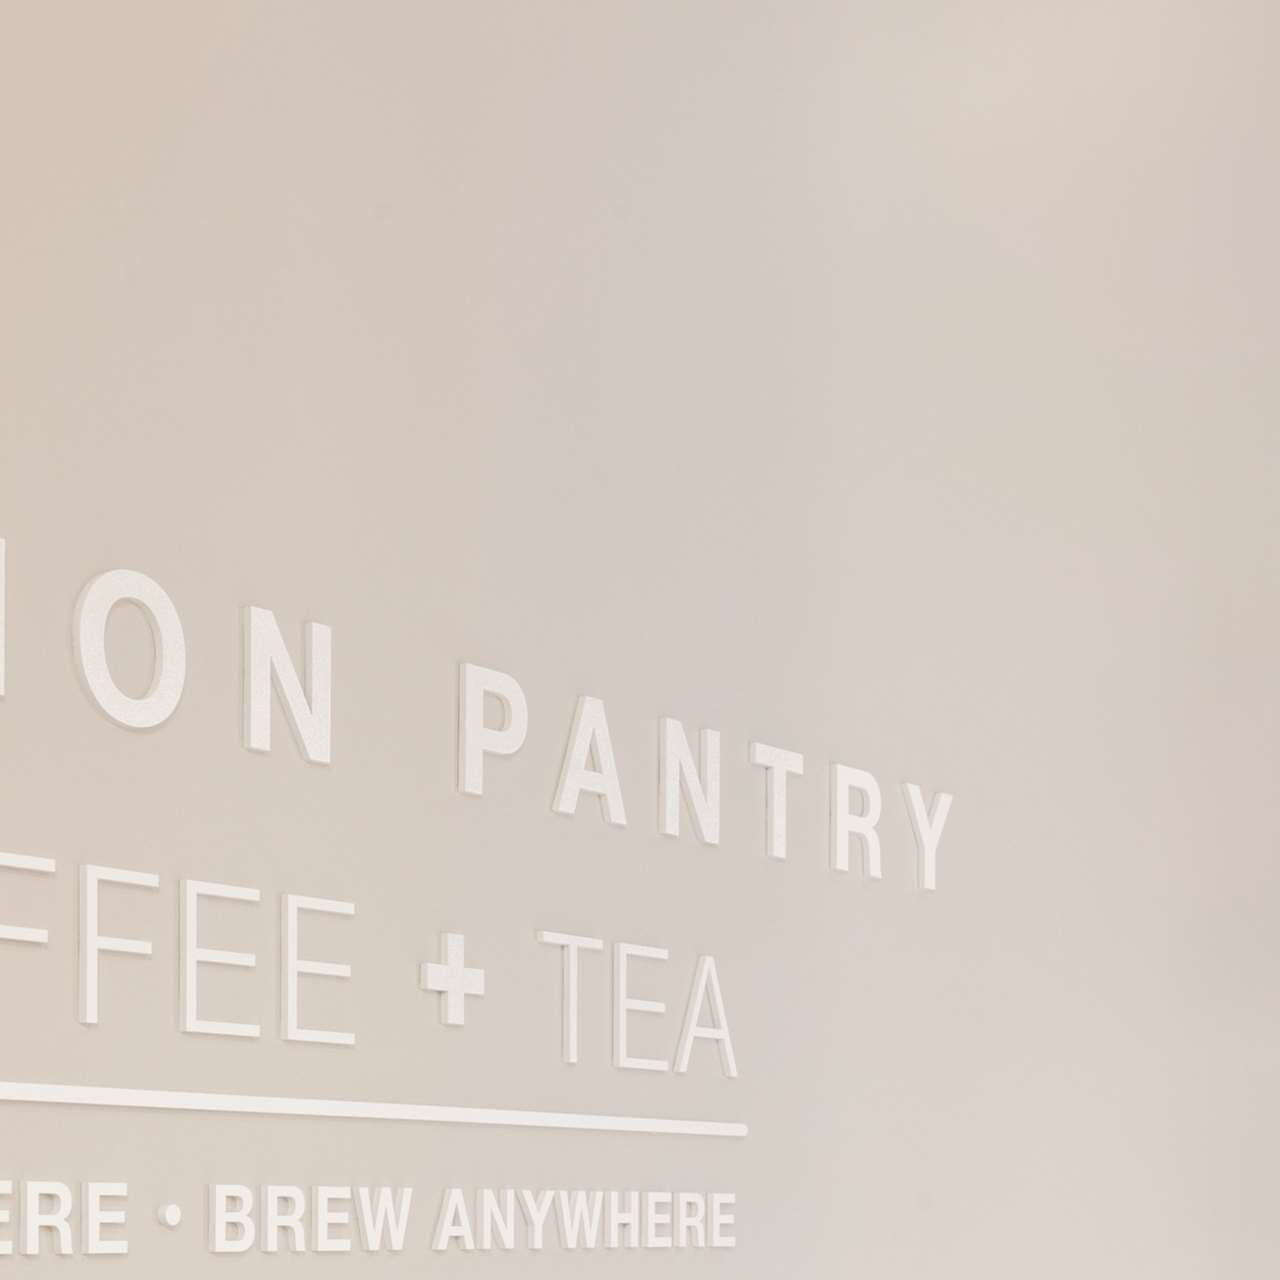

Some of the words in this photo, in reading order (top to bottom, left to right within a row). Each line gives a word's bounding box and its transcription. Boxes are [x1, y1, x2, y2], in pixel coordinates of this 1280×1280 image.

[458, 662, 953, 890] PANTRY
[535, 930, 739, 1078] TEA
[209, 1183, 413, 1254] BREW
[431, 1186, 737, 1252] ANYWHERE
